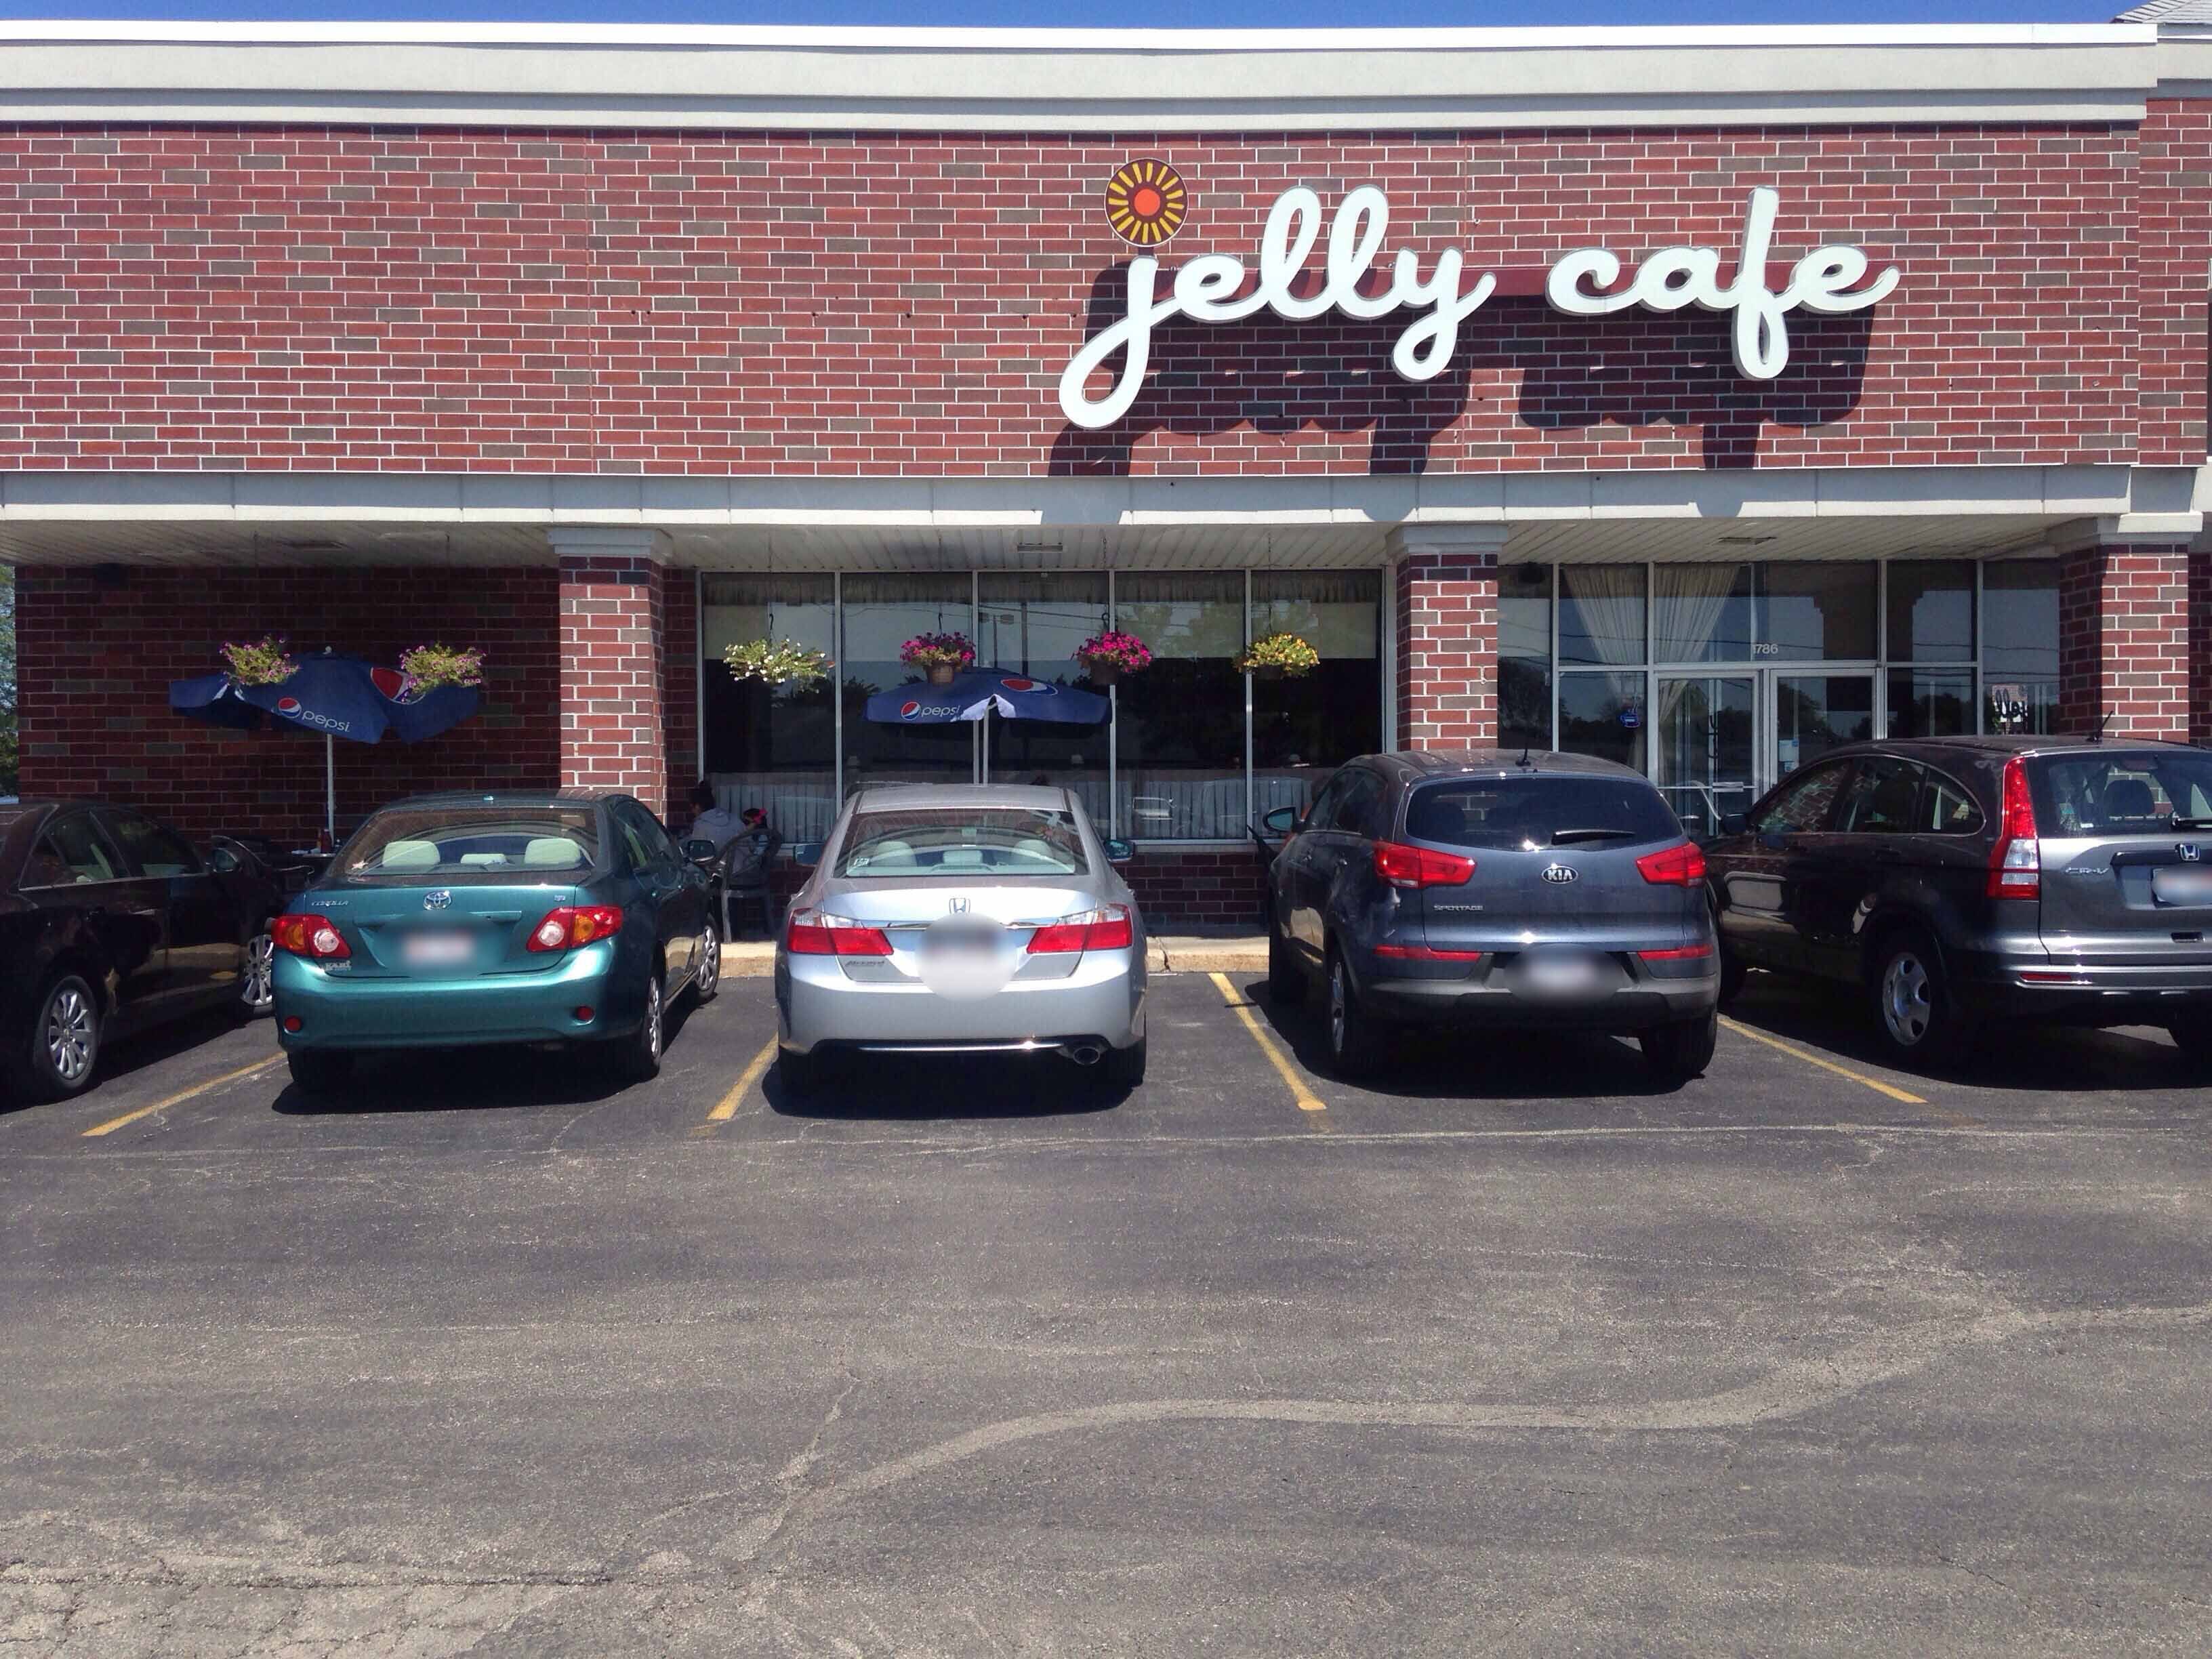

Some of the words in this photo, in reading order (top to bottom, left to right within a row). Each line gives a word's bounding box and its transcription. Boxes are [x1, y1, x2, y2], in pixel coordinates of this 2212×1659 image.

[1059, 184, 1497, 430] jelly
[1547, 185, 1901, 381] cafe
[922, 705, 960, 717] pepsi
[302, 710, 350, 732] pepsi
[1547, 869, 1573, 880] KIA
